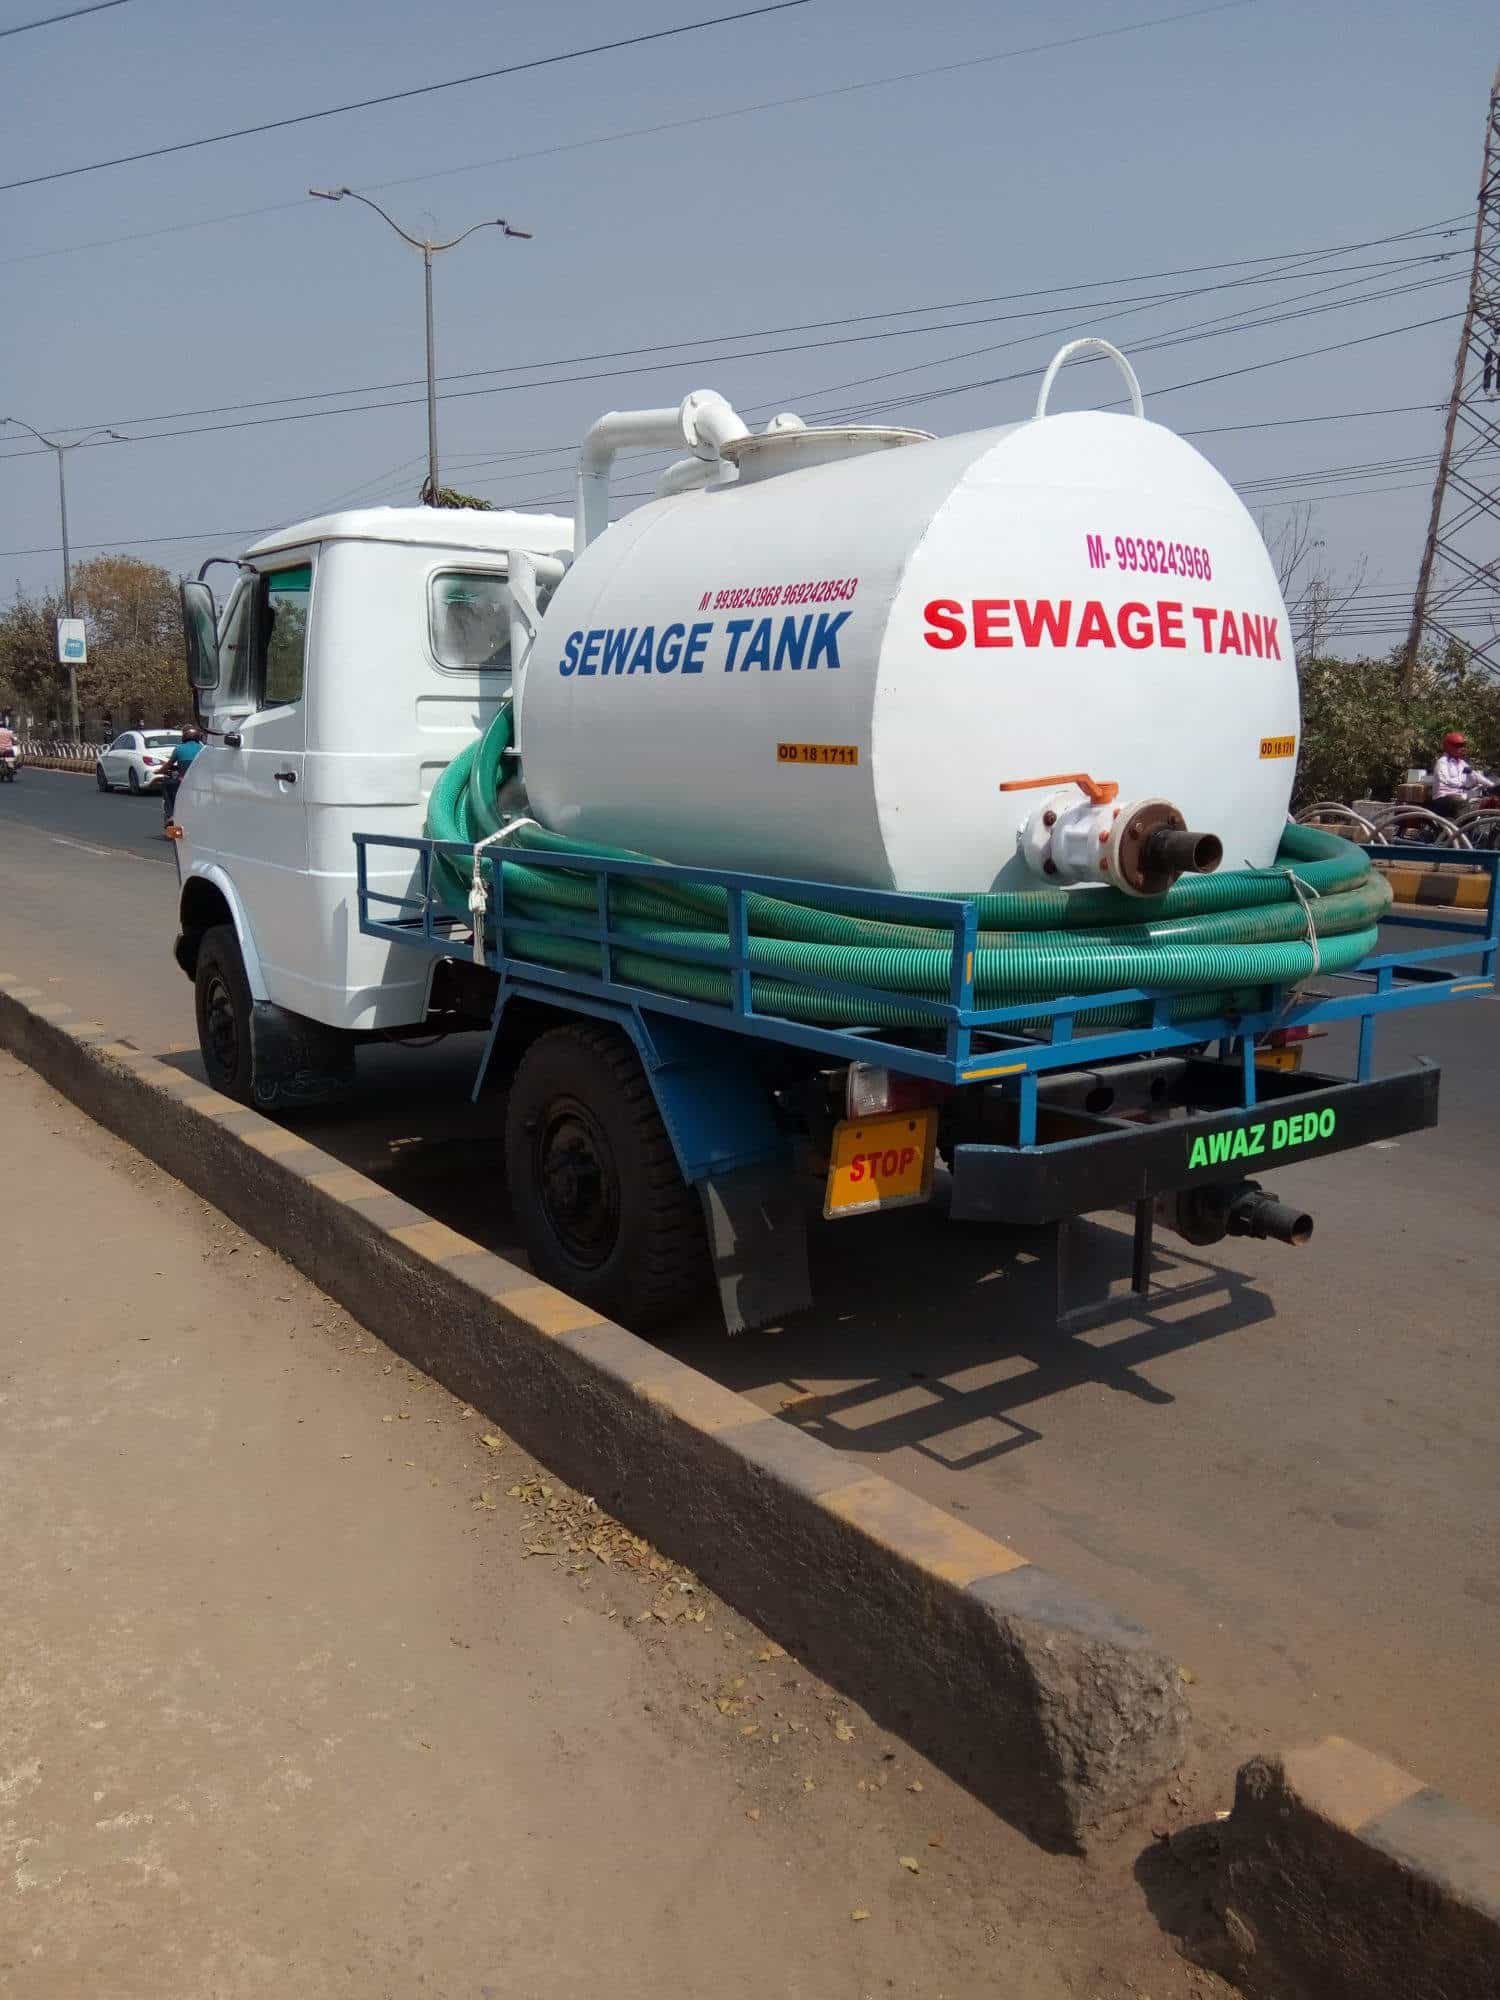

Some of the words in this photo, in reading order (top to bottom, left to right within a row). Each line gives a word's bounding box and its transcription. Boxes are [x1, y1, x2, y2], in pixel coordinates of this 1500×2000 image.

[1115, 536, 1212, 581] 9938243968
[713, 587, 781, 609] 9938243968
[781, 577, 858, 605] 9692428543
[559, 622, 713, 677] SEWAGE
[724, 611, 853, 672] TANK
[923, 599, 1186, 649] SEWAGE
[1193, 607, 1282, 660] TANK
[802, 746, 817, 761] 18
[822, 748, 855, 763] 1711
[1188, 1123, 1266, 1169] AWAZ
[1272, 1107, 1336, 1150] DEDO
[849, 1147, 915, 1182] STOP
